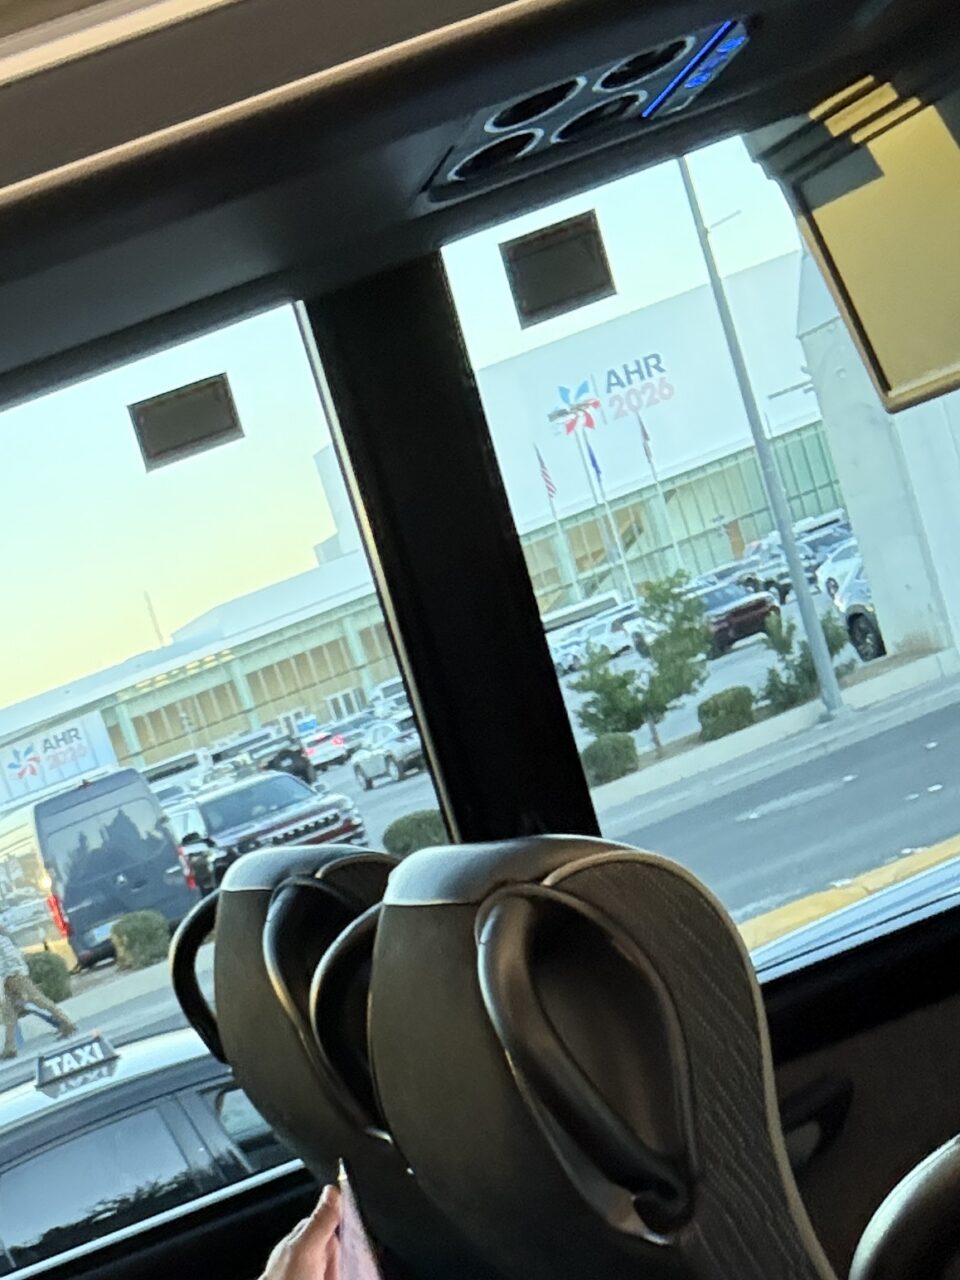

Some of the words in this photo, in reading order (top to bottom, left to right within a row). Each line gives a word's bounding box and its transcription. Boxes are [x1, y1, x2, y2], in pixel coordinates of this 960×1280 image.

[605, 353, 666, 394] AHR
[608, 376, 675, 421] 2026
[43, 727, 82, 753] AHR
[44, 1042, 104, 1076] TAXI
